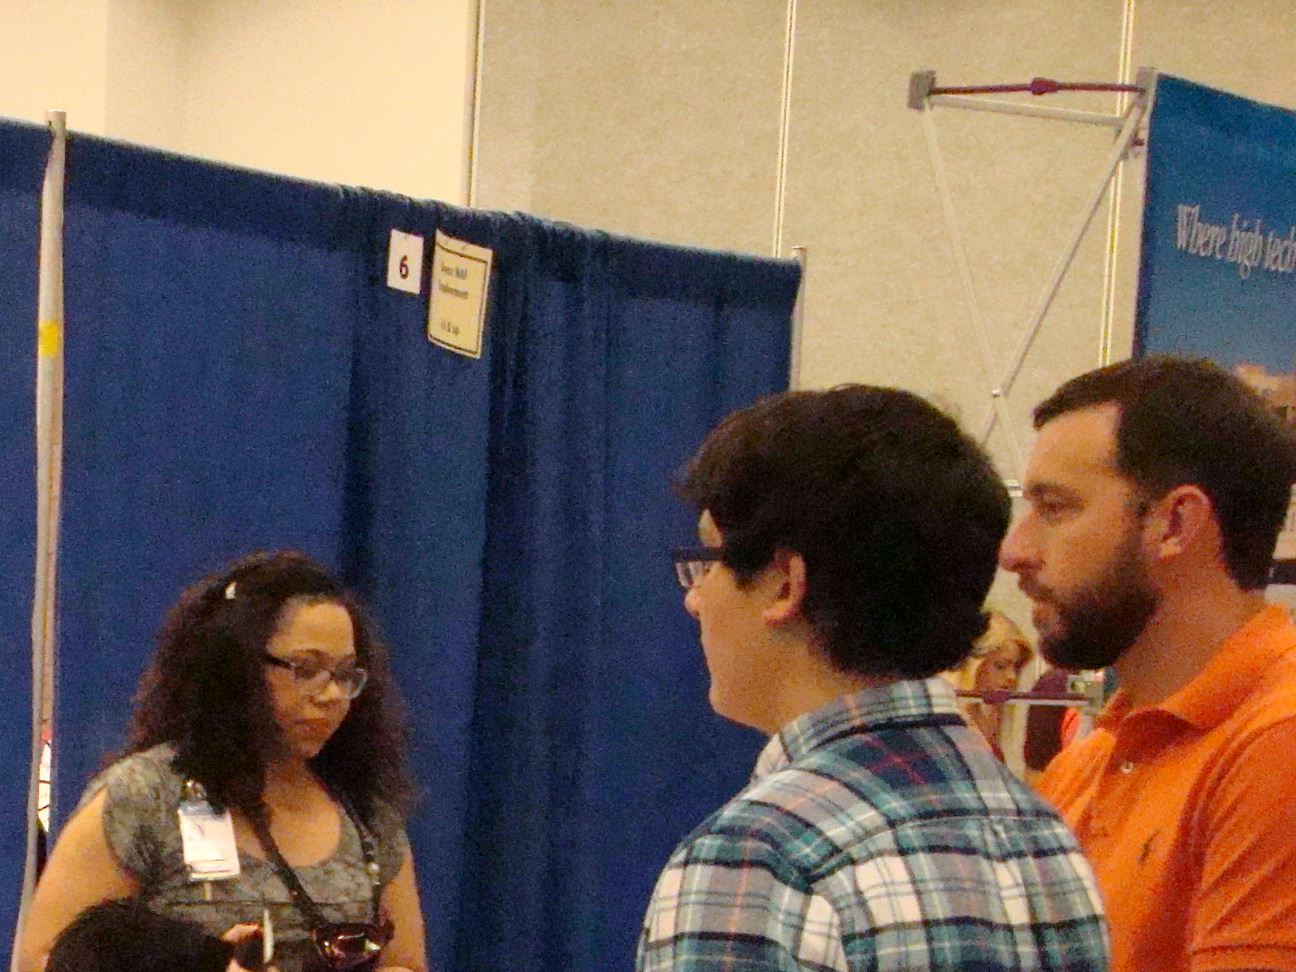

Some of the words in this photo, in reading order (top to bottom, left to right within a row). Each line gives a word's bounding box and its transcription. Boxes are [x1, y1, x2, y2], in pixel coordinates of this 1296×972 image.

[1177, 204, 1226, 260] Where
[1227, 212, 1263, 279] high
[399, 255, 409, 280] 6
